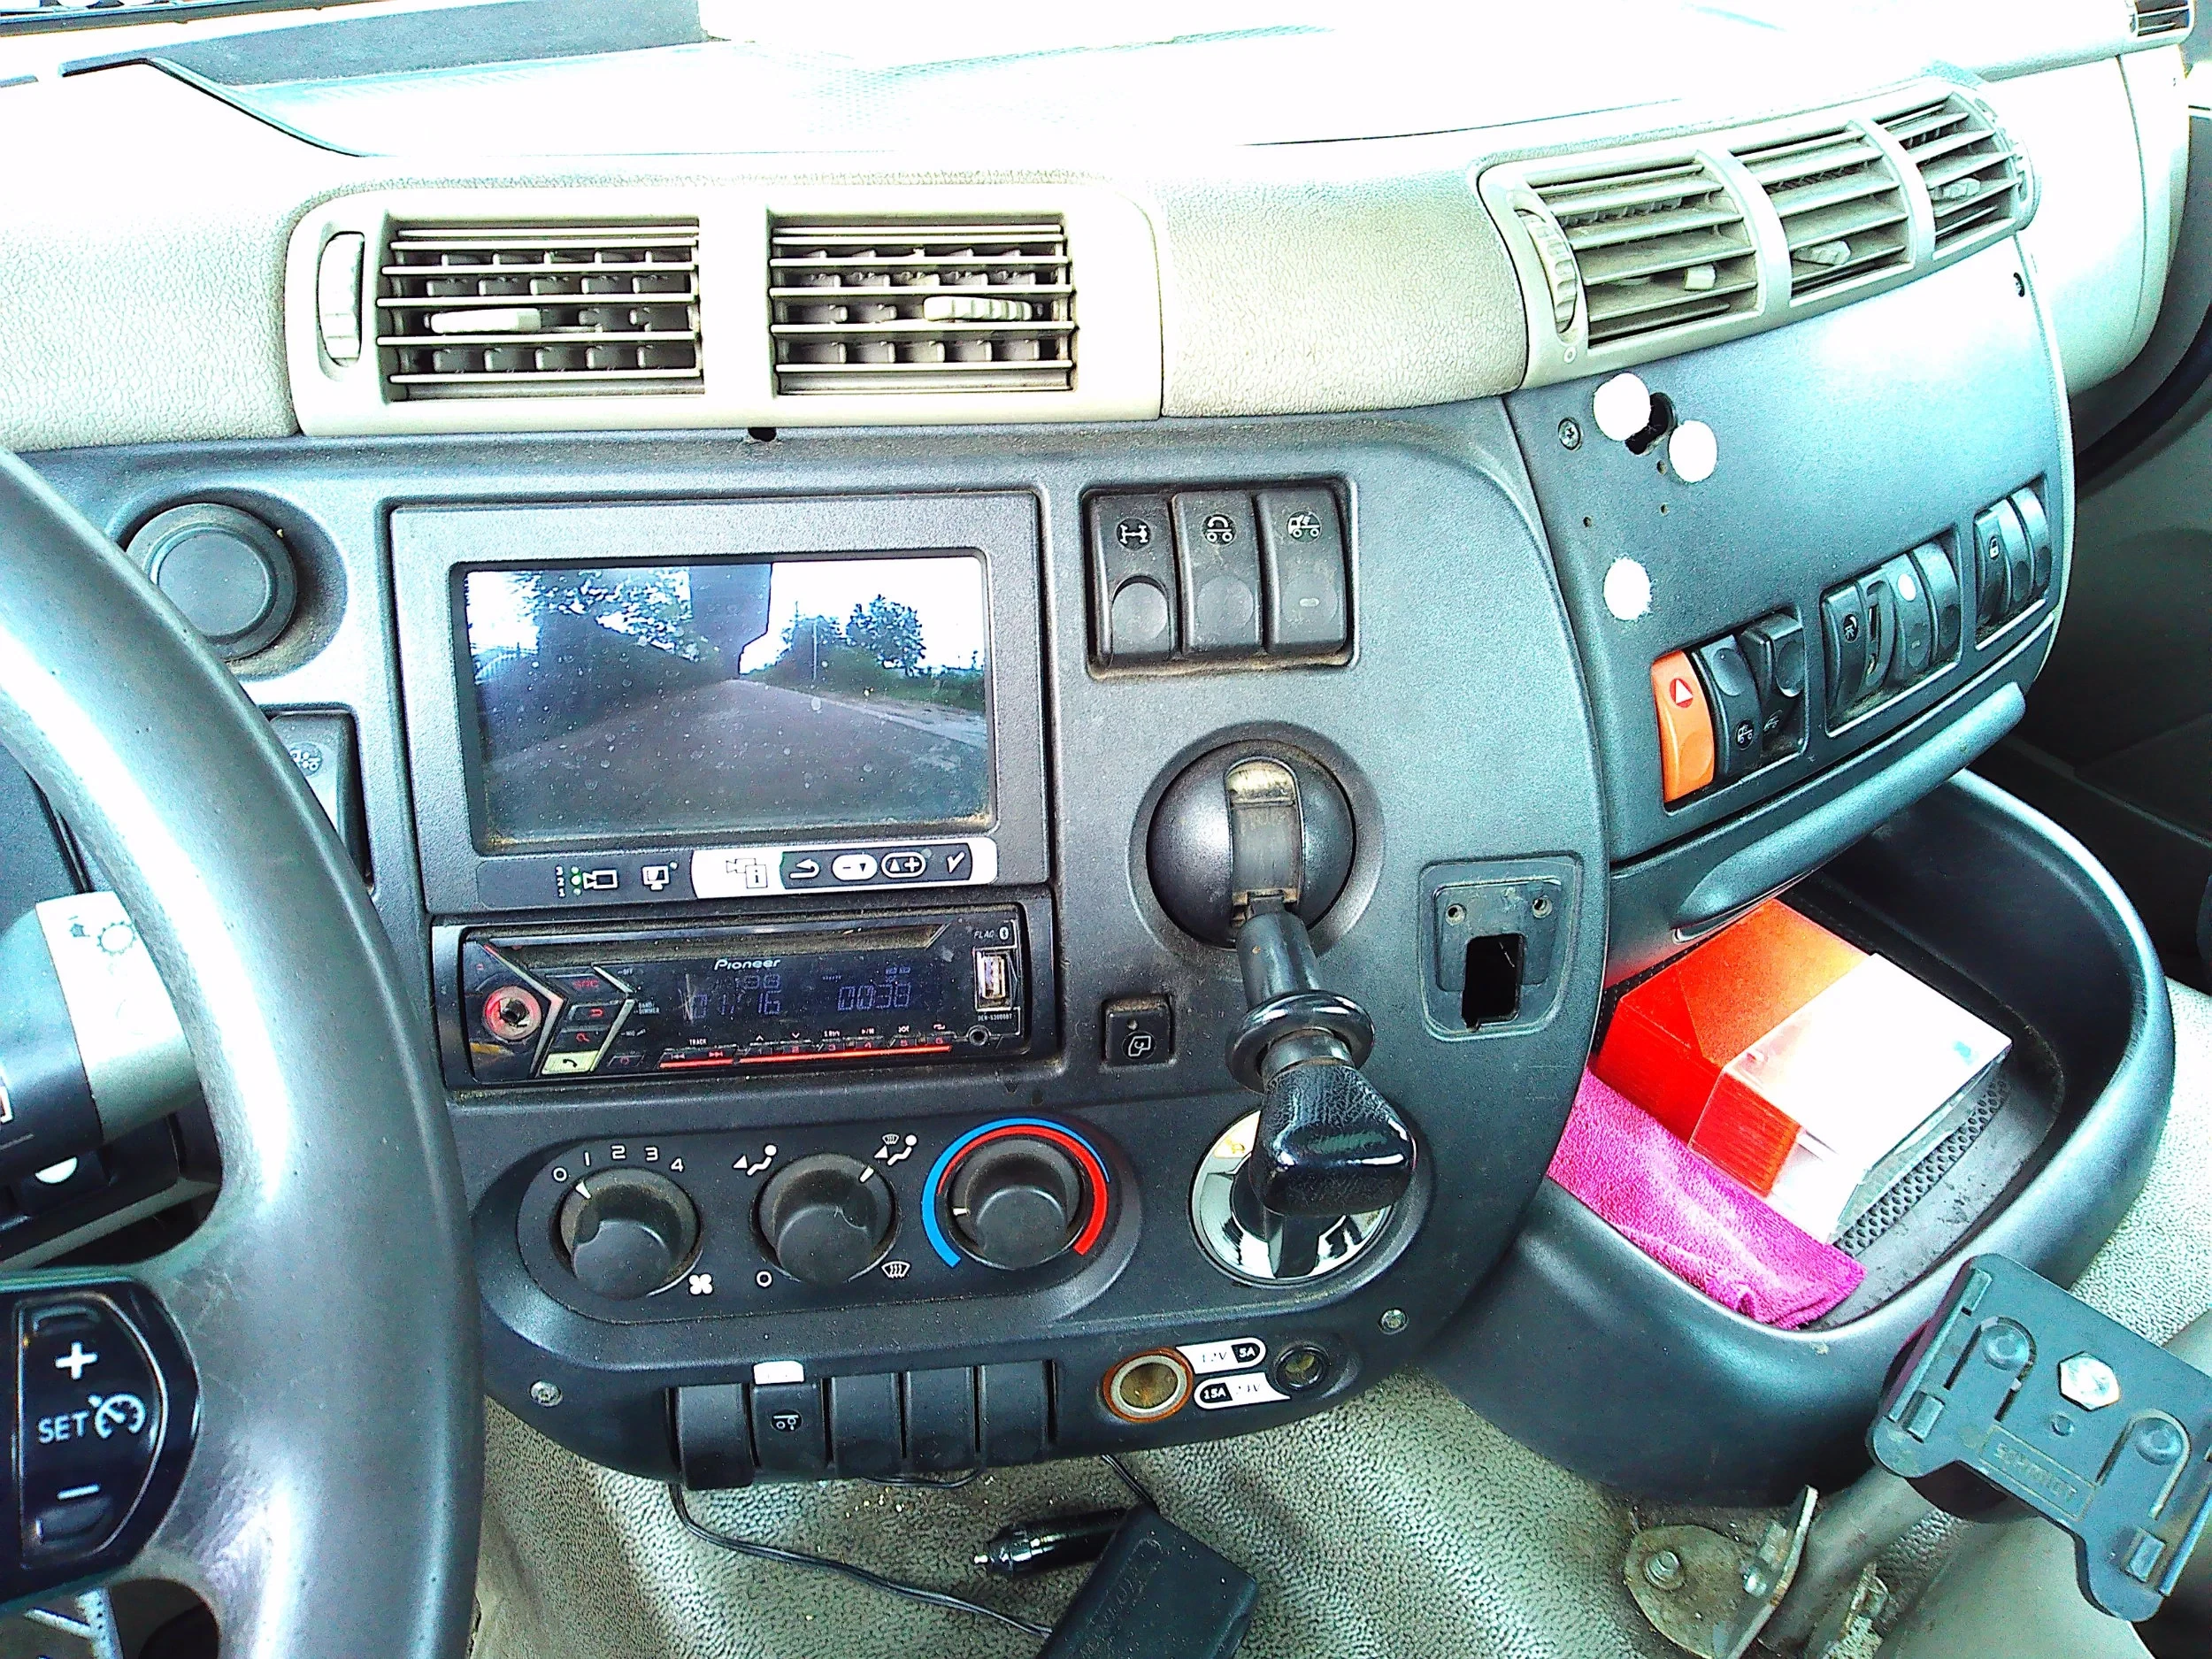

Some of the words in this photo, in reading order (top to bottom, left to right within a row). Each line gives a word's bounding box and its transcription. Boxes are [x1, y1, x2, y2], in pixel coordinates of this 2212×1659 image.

[557, 877, 565, 887] 2
[714, 958, 781, 971] Pioneer
[611, 1145, 626, 1160] 2
[645, 1147, 659, 1161] 3
[671, 1158, 684, 1172] 4
[1239, 1347, 1256, 1358] 5A
[1203, 1387, 1226, 1400] 15A
[38, 1409, 90, 1444] SET
